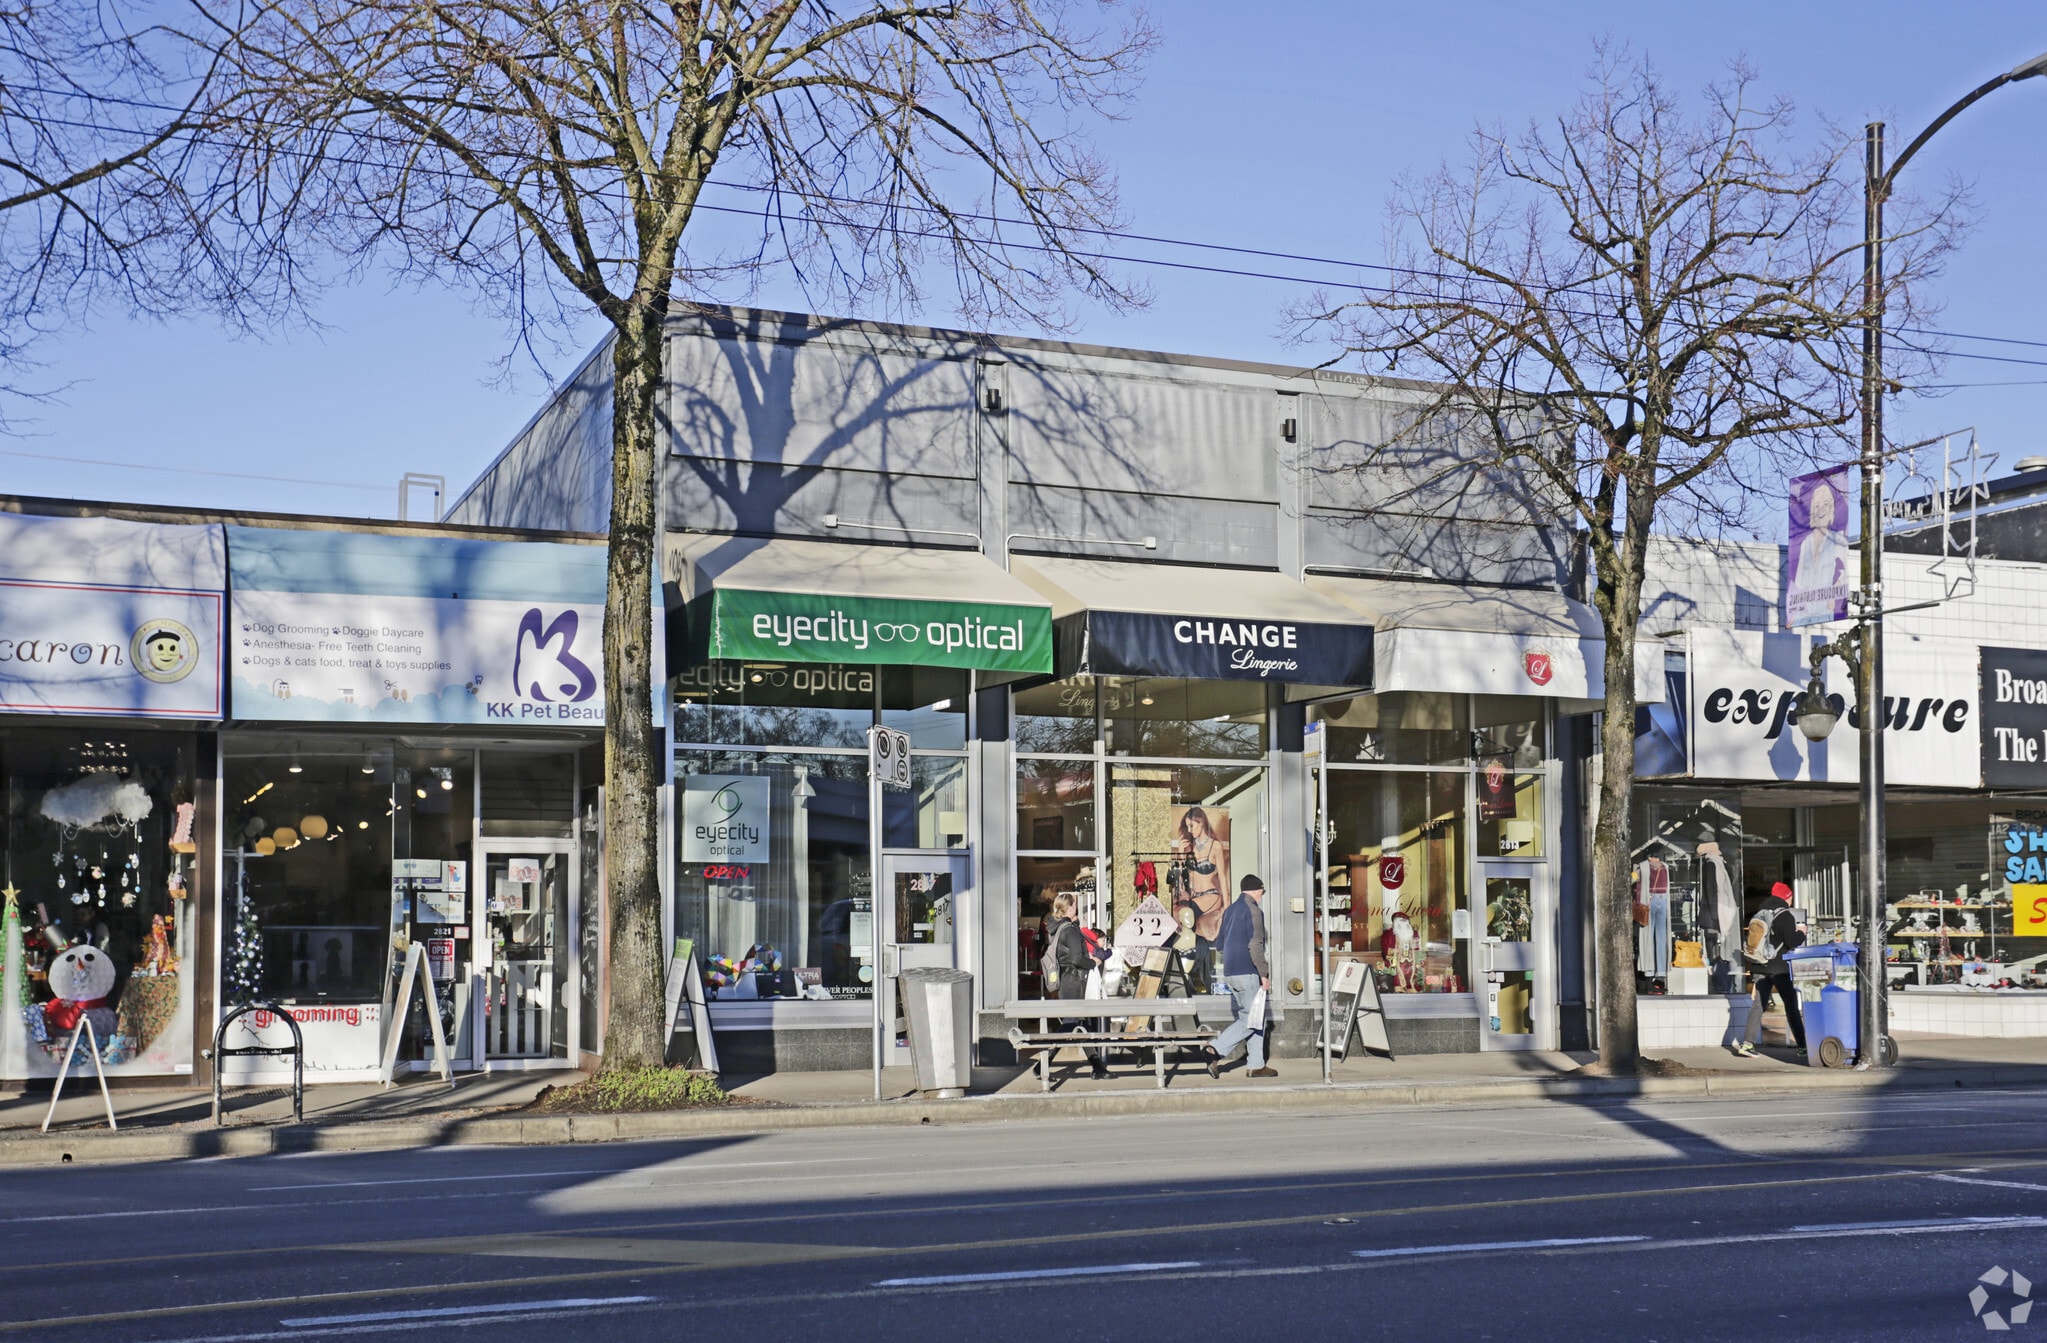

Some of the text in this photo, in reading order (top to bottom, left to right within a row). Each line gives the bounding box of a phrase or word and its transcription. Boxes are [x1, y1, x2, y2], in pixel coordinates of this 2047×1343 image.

[253, 623, 424, 638] Dog Grooming Doggie Daycare
[752, 610, 868, 650] eyecity
[926, 616, 1023, 653] optical
[1174, 620, 1297, 648] CHANGE
[253, 640, 422, 655] Anesthesia- Free Teeth Cleaning
[253, 656, 452, 671] Dogs & cats food, treat & toys supplies
[1230, 648, 1297, 677] Lingerie
[1994, 668, 2047, 705] Broa
[487, 702, 515, 718] KK
[521, 703, 552, 718] Pet
[1993, 727, 2038, 763] The
[695, 823, 759, 844] eyecity
[710, 845, 745, 856] optical
[1500, 839, 1520, 850] 2813
[509, 866, 539, 881] SALE
[703, 865, 750, 879] OPEN
[910, 879, 936, 891] 287
[432, 946, 451, 955] OPEN
[842, 986, 873, 994] PEOPLES
